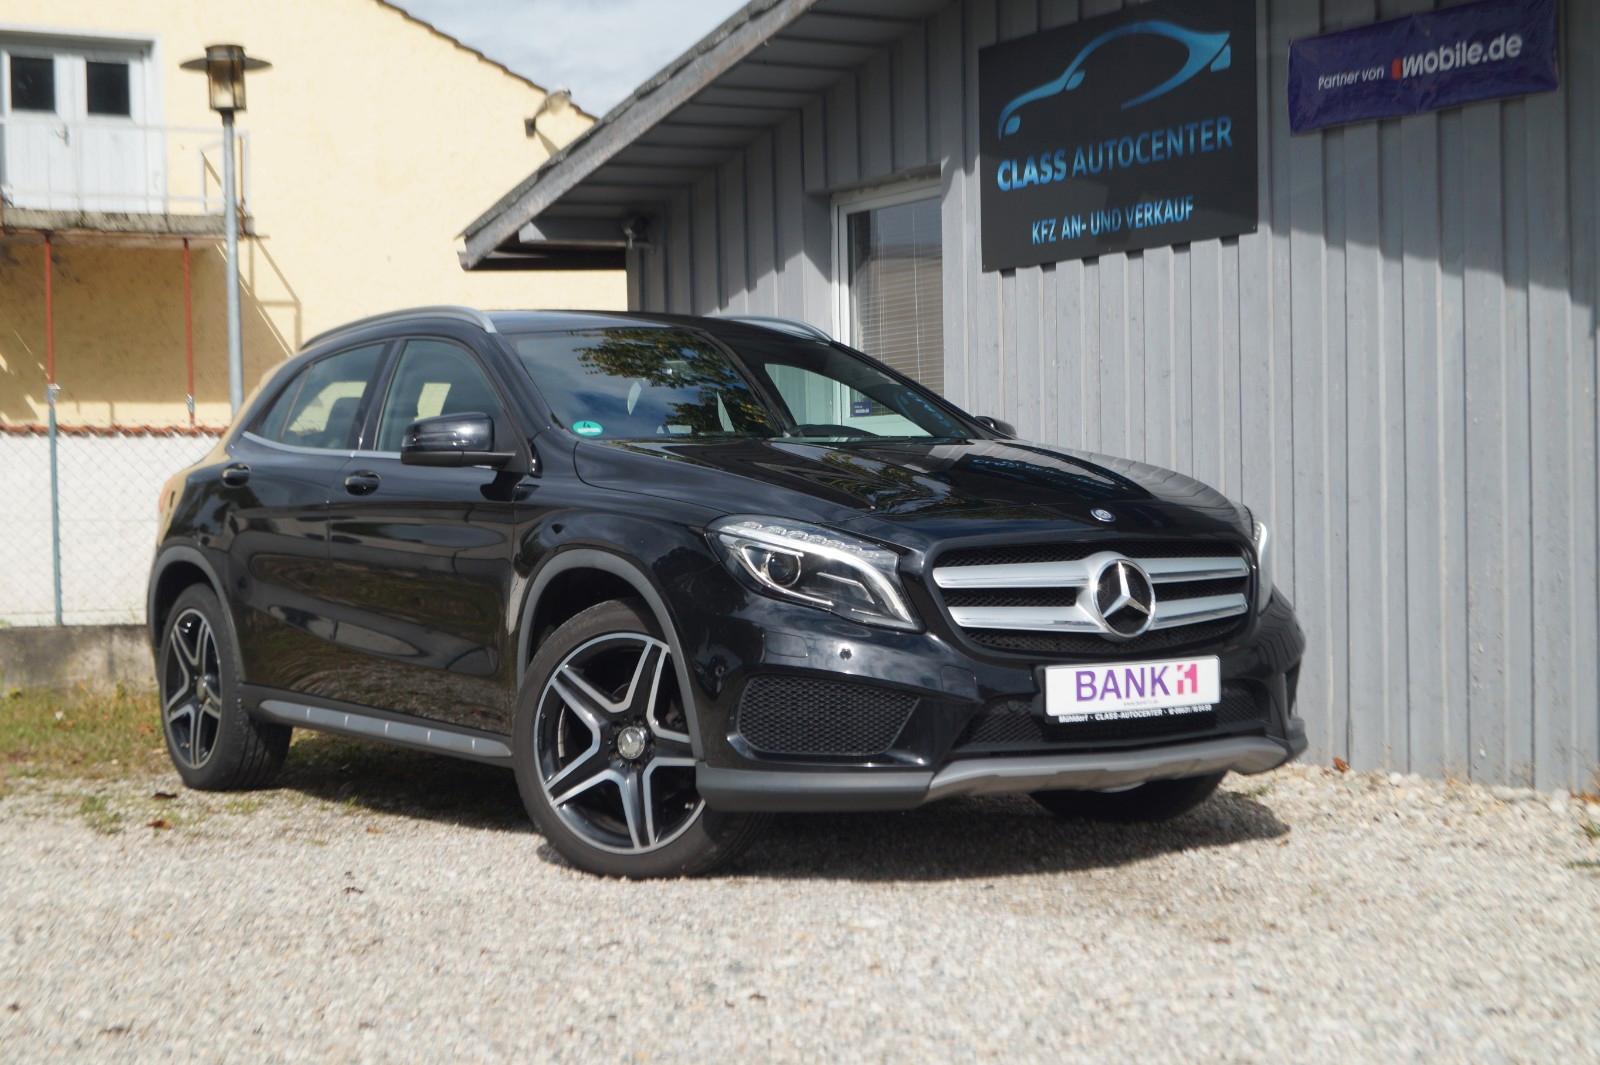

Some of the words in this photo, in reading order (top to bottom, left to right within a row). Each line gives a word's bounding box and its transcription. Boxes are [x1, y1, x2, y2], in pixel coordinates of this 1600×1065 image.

[1318, 69, 1360, 90] Partner
[1361, 64, 1385, 82] von
[1401, 33, 1523, 78] mobile.de
[996, 149, 1067, 191] CLASS
[1071, 116, 1233, 177] AUTOCENTER
[1032, 217, 1057, 245] KFZ
[1061, 214, 1087, 240] AN-
[1090, 207, 1121, 232] UND
[1125, 195, 1194, 229] VERKAUF
